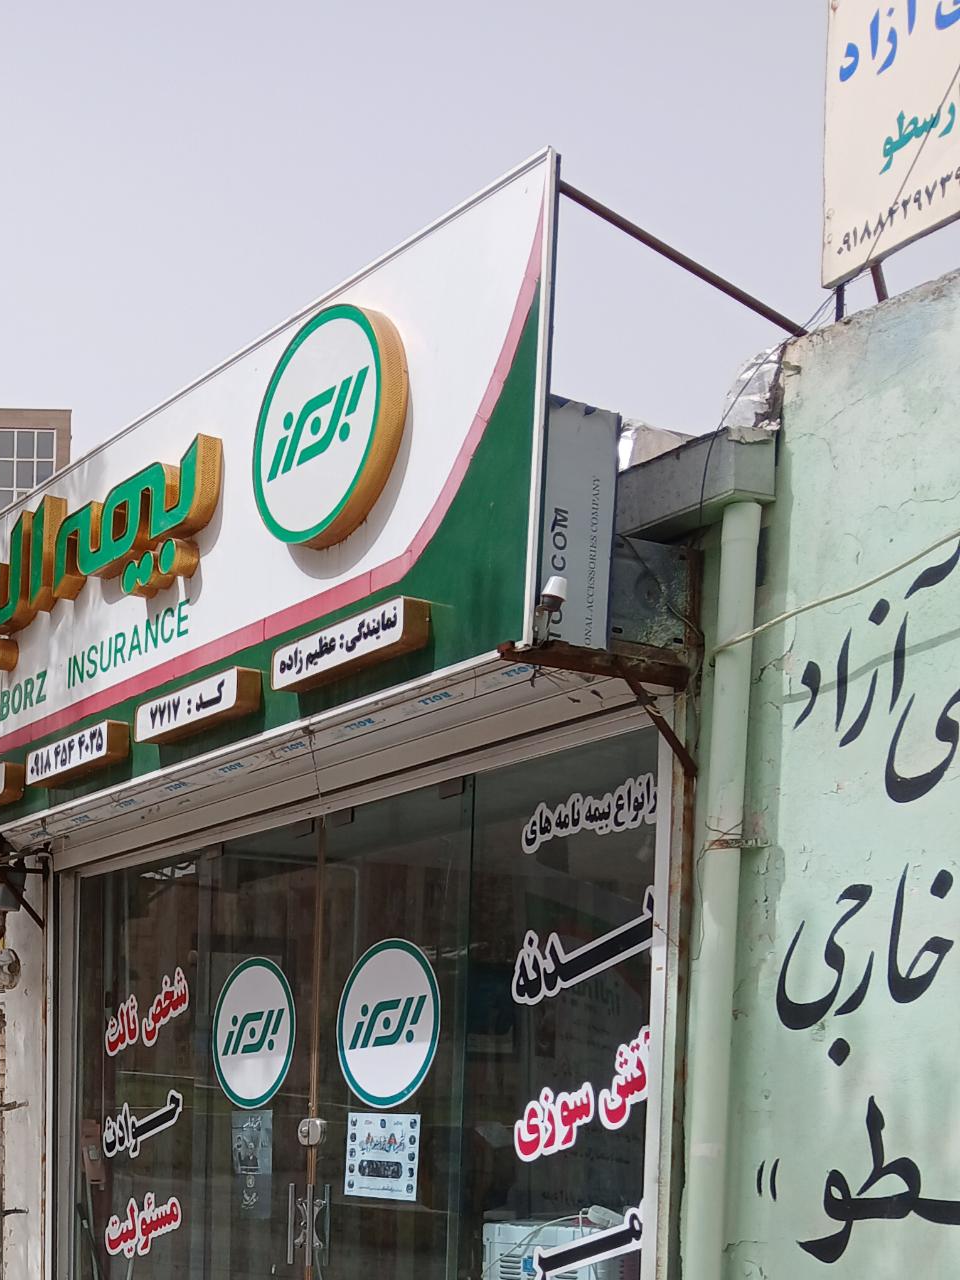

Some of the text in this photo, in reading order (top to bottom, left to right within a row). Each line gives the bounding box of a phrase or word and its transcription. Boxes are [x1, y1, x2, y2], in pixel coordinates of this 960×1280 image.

[879, 102, 960, 175] رسطو
[53, 433, 223, 600] بیمه
[590, 475, 601, 534] COMPANY
[66, 598, 191, 690] INSURANCE
[585, 802, 611, 830] بیمه
[776, 862, 954, 1067] خارجی
[144, 968, 188, 1044] شخص
[603, 1030, 651, 1124] تش
[517, 1086, 592, 1157] سوزی
